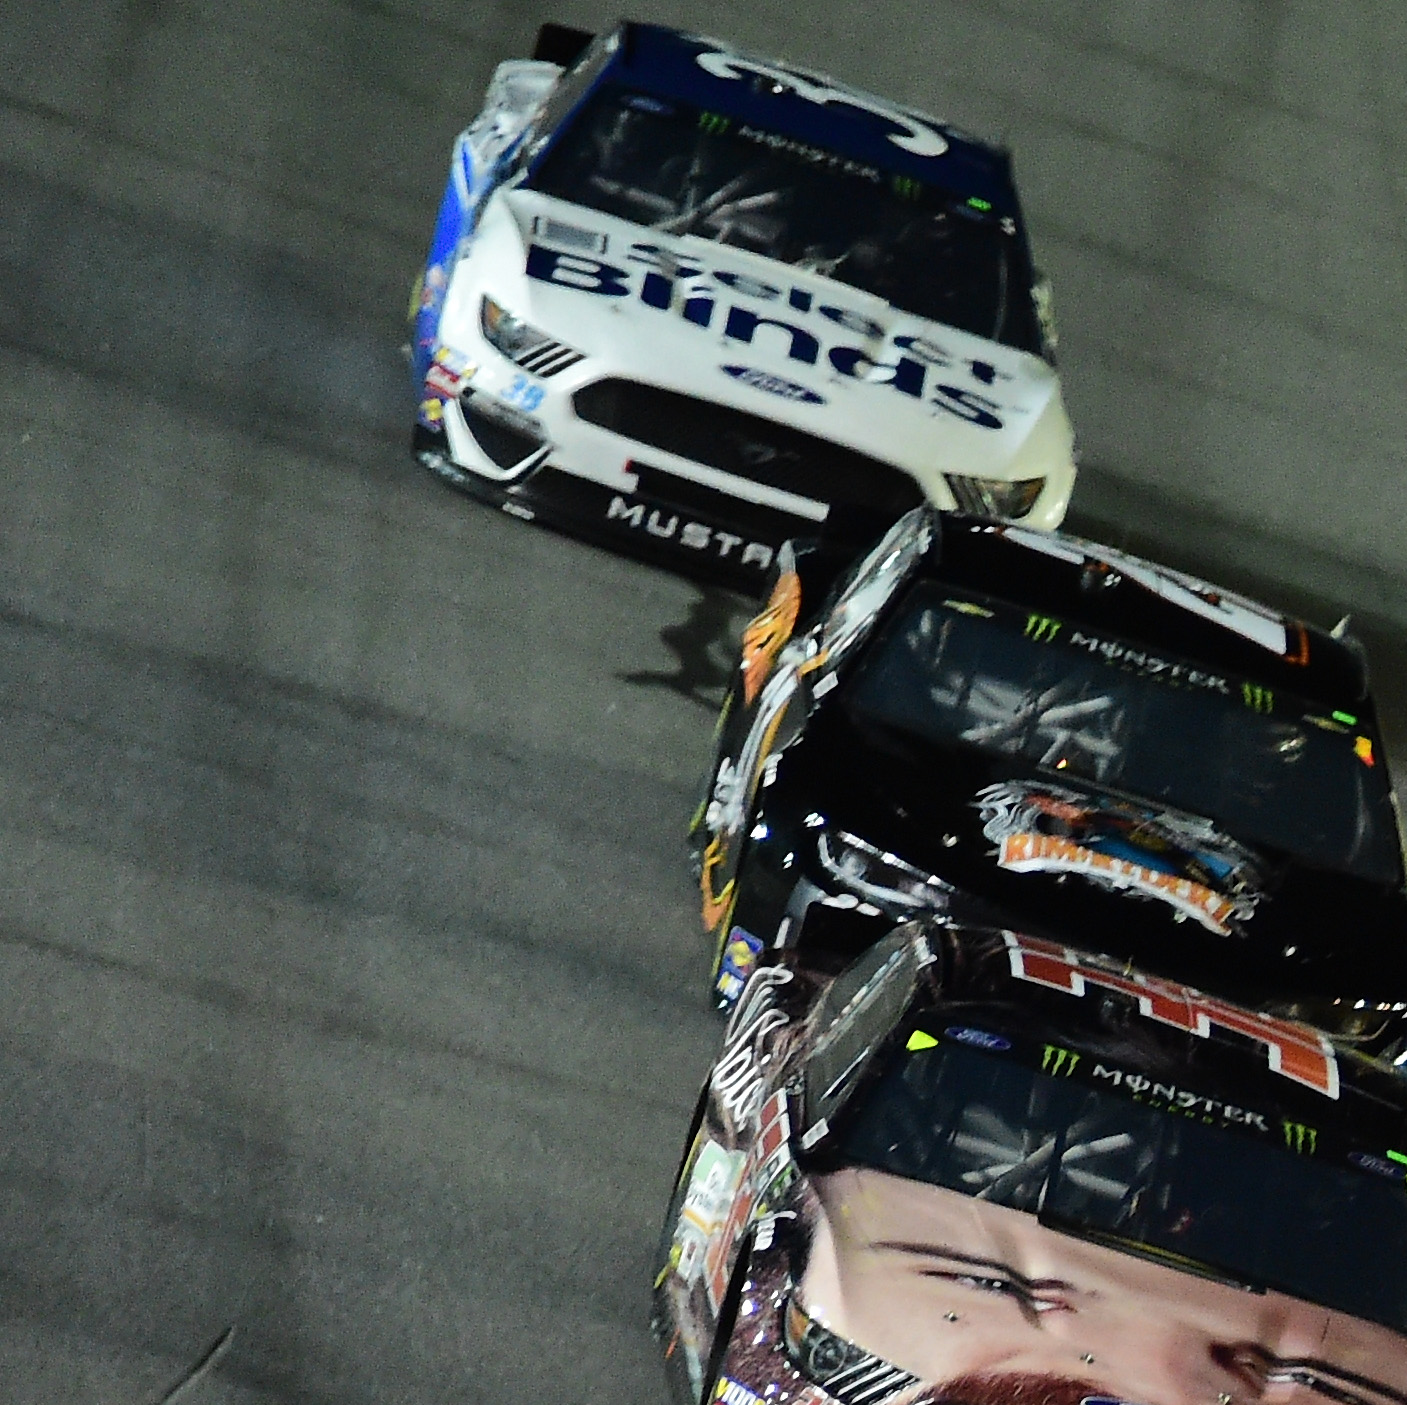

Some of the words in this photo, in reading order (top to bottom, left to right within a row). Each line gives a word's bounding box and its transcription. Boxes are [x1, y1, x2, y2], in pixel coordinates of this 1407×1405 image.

[525, 243, 1004, 430] Blinds
[627, 243, 1008, 385] Select
[606, 496, 775, 570] MUSTA
[1070, 631, 1230, 695] MONSTER
[1092, 1063, 1269, 1132] MONSTER
